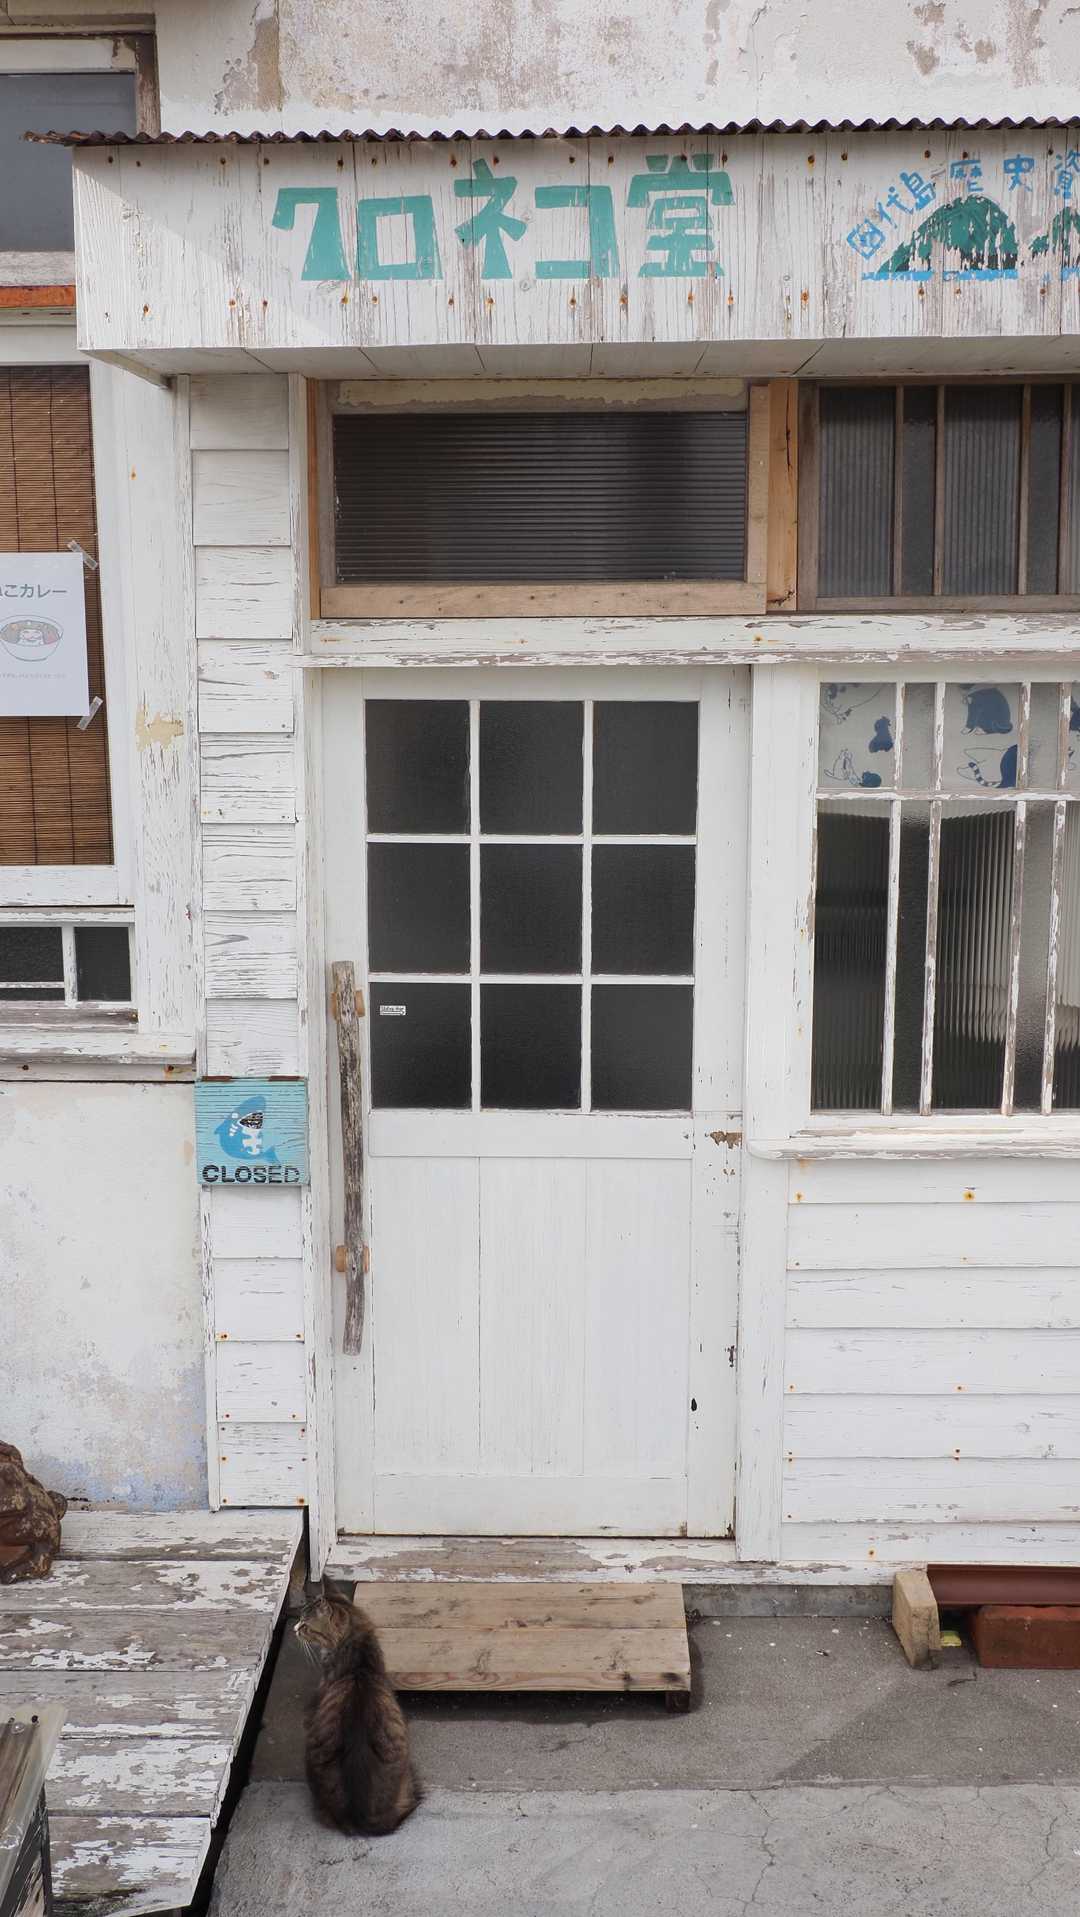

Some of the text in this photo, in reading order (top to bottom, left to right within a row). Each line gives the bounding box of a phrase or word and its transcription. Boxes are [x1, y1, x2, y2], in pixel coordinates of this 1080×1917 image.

[271, 153, 736, 280] クロネコ堂
[0, 583, 67, 598] こカレー
[202, 1165, 300, 1183] CLOSED
